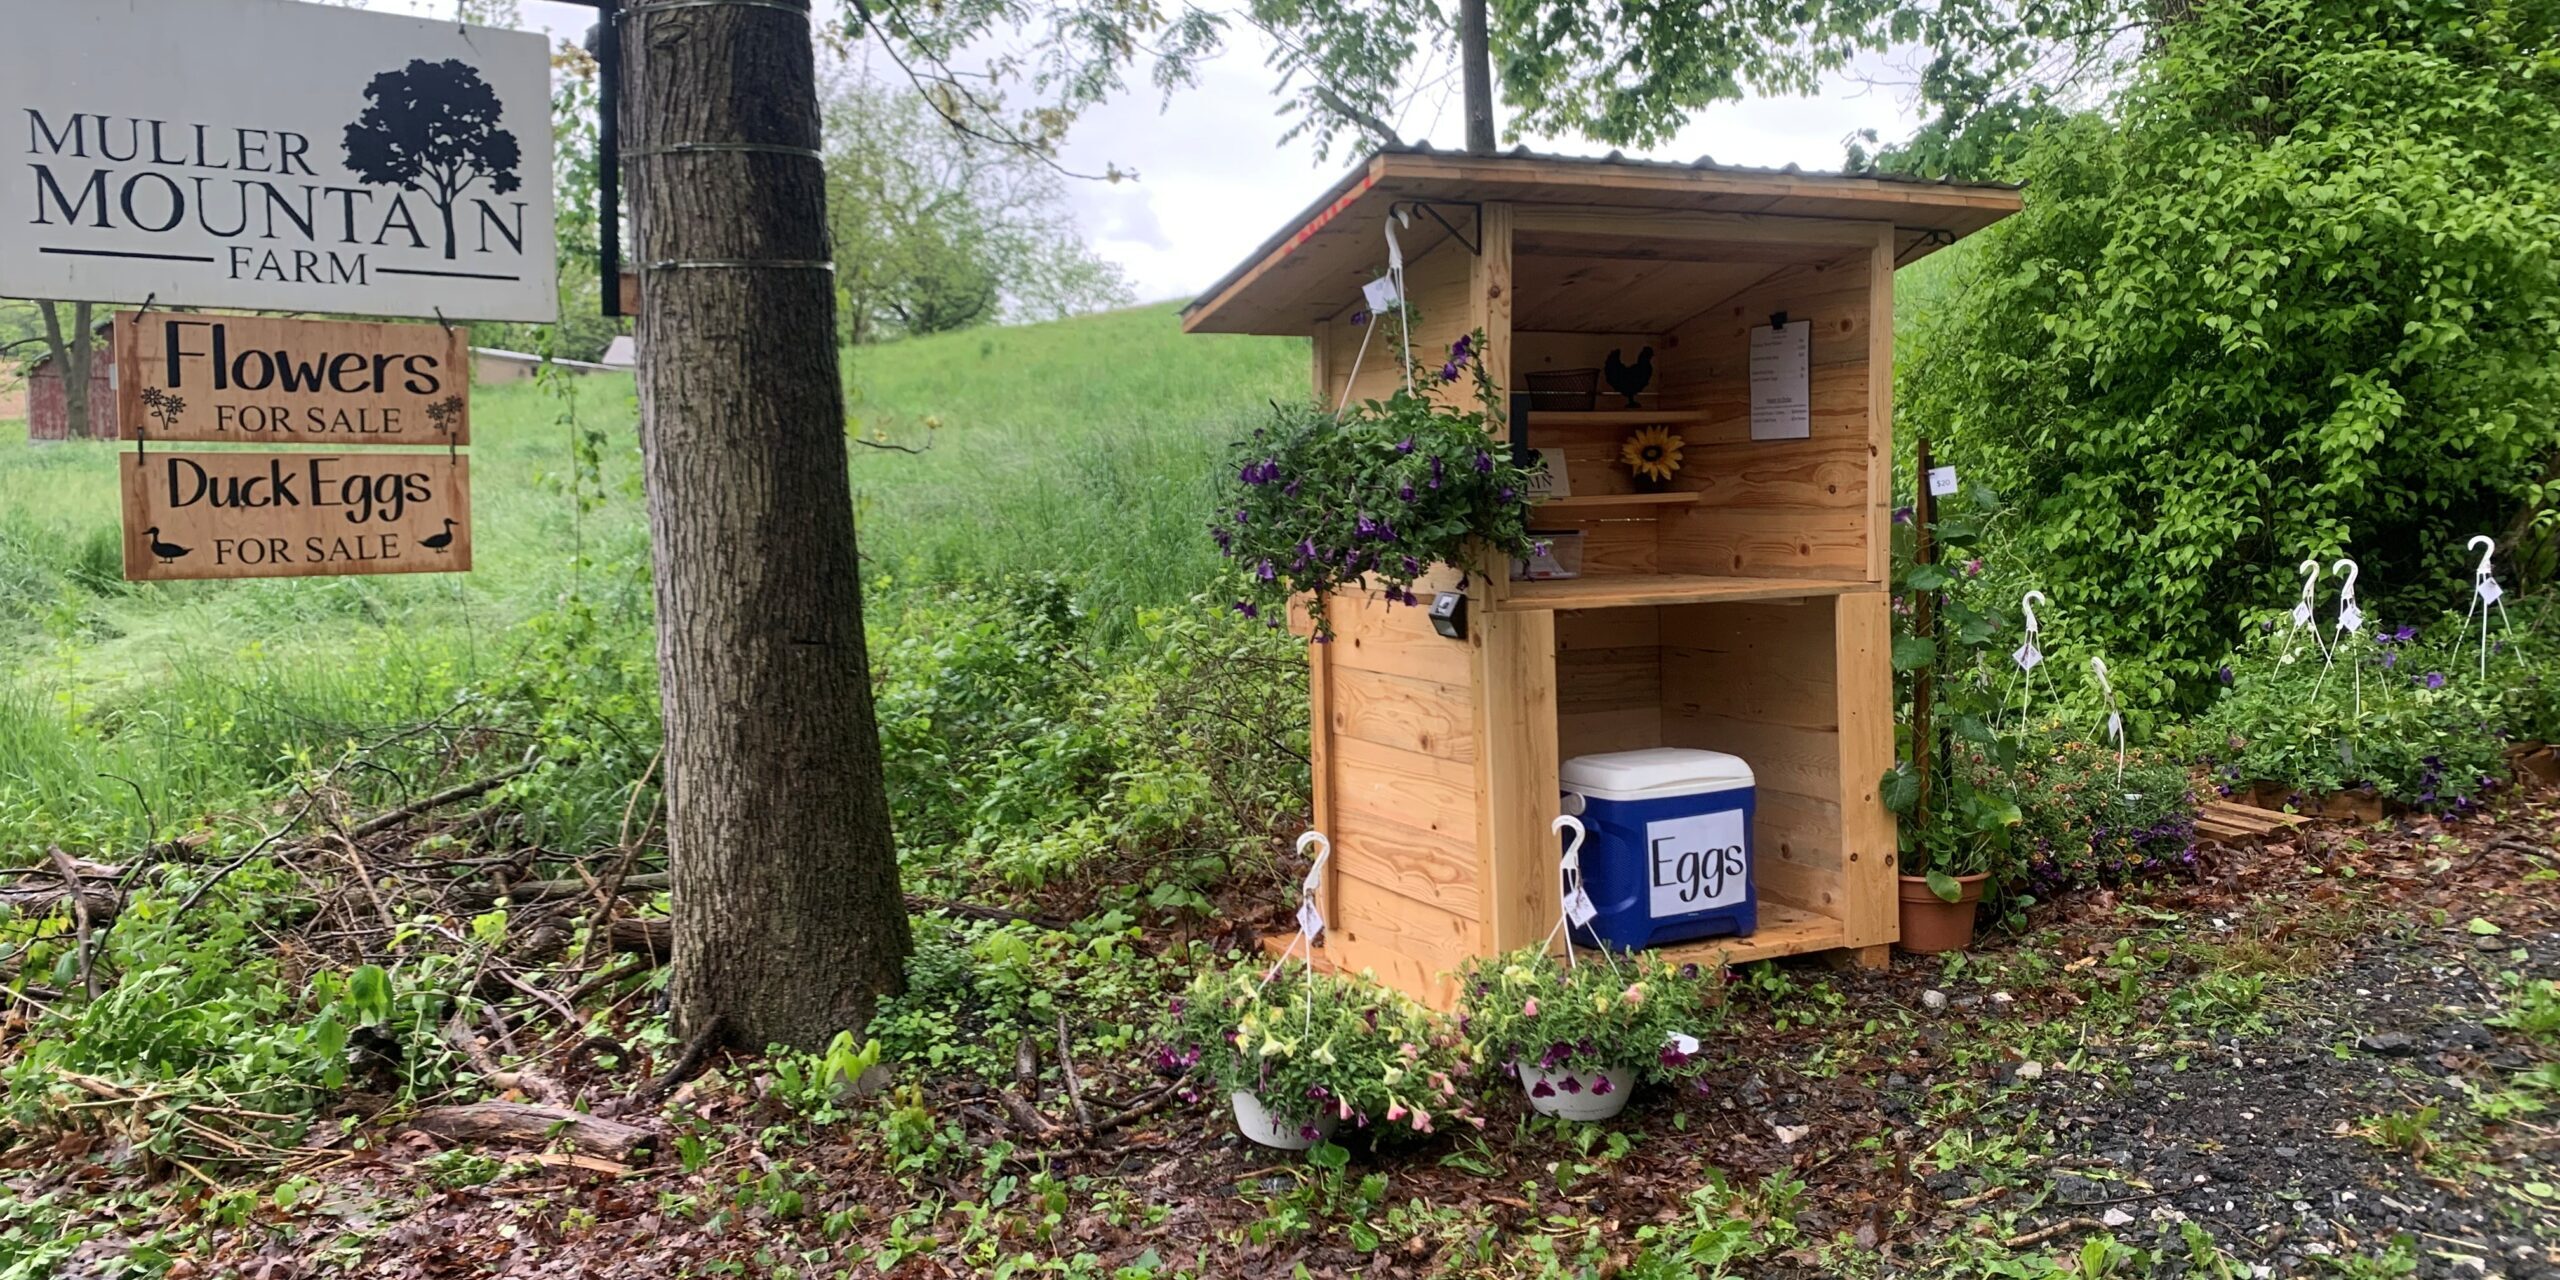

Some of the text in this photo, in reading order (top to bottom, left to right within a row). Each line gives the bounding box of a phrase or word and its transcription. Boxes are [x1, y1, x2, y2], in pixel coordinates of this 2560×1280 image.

[23, 108, 319, 177] MULLER
[227, 246, 370, 286] FARM
[165, 320, 440, 395] Flowers
[215, 405, 403, 434] FOR SALE
[167, 457, 432, 524] Duck Eggs
[1936, 479, 1951, 488] $20
[213, 533, 401, 565] FOR SALE
[1651, 836, 1744, 903] Eggs
